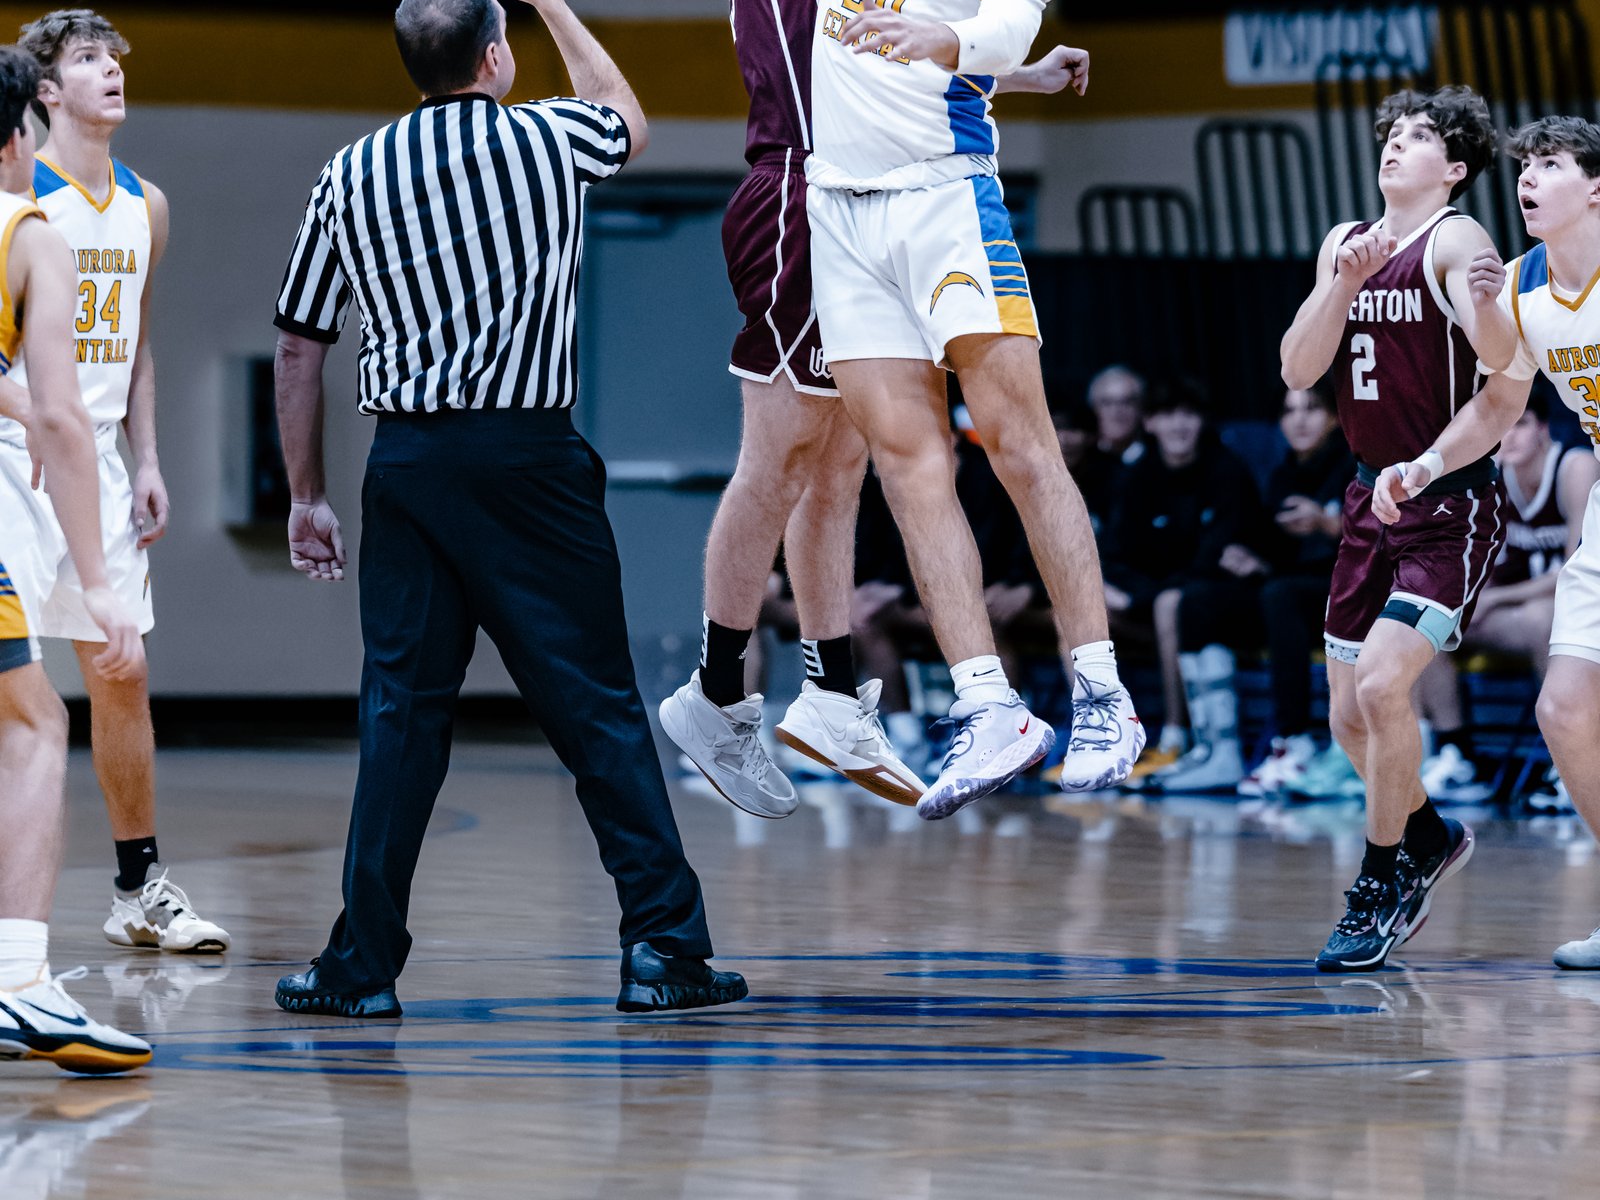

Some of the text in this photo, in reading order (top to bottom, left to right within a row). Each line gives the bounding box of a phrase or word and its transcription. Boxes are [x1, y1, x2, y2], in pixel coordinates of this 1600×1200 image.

[72, 249, 137, 273] URORA
[75, 280, 122, 333] 34
[73, 339, 128, 364] NTRAL
[1351, 333, 1379, 400] 2
[1547, 344, 1600, 373] AURO
[1568, 374, 1600, 418] 3
